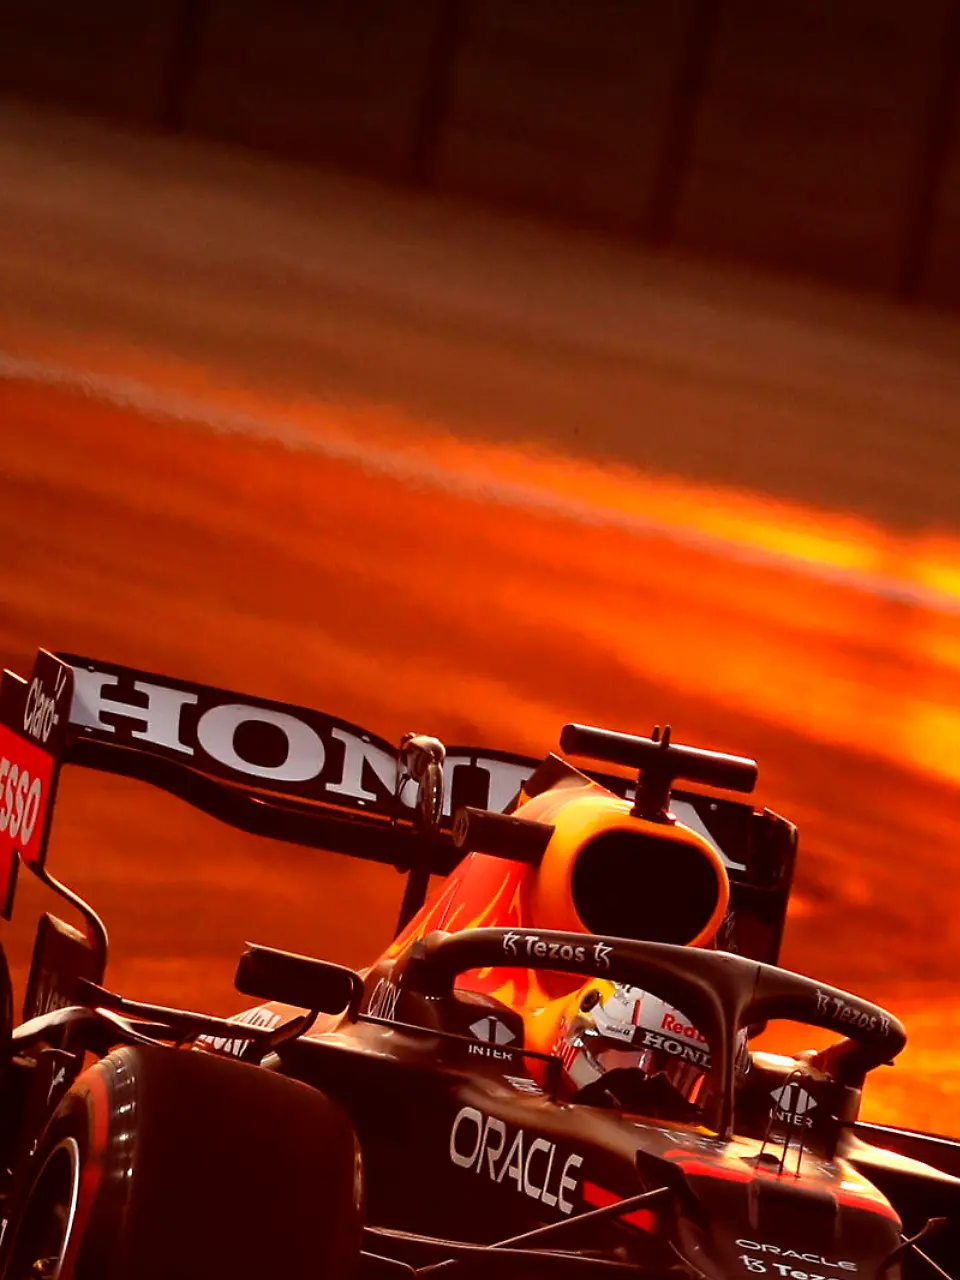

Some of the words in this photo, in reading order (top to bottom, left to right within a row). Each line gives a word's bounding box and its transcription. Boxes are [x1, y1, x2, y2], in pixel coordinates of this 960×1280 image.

[525, 935, 586, 963] Tezos
[832, 998, 877, 1032] Tezos
[449, 1106, 584, 1215] ORACLE
[735, 1239, 858, 1272] ORACLE
